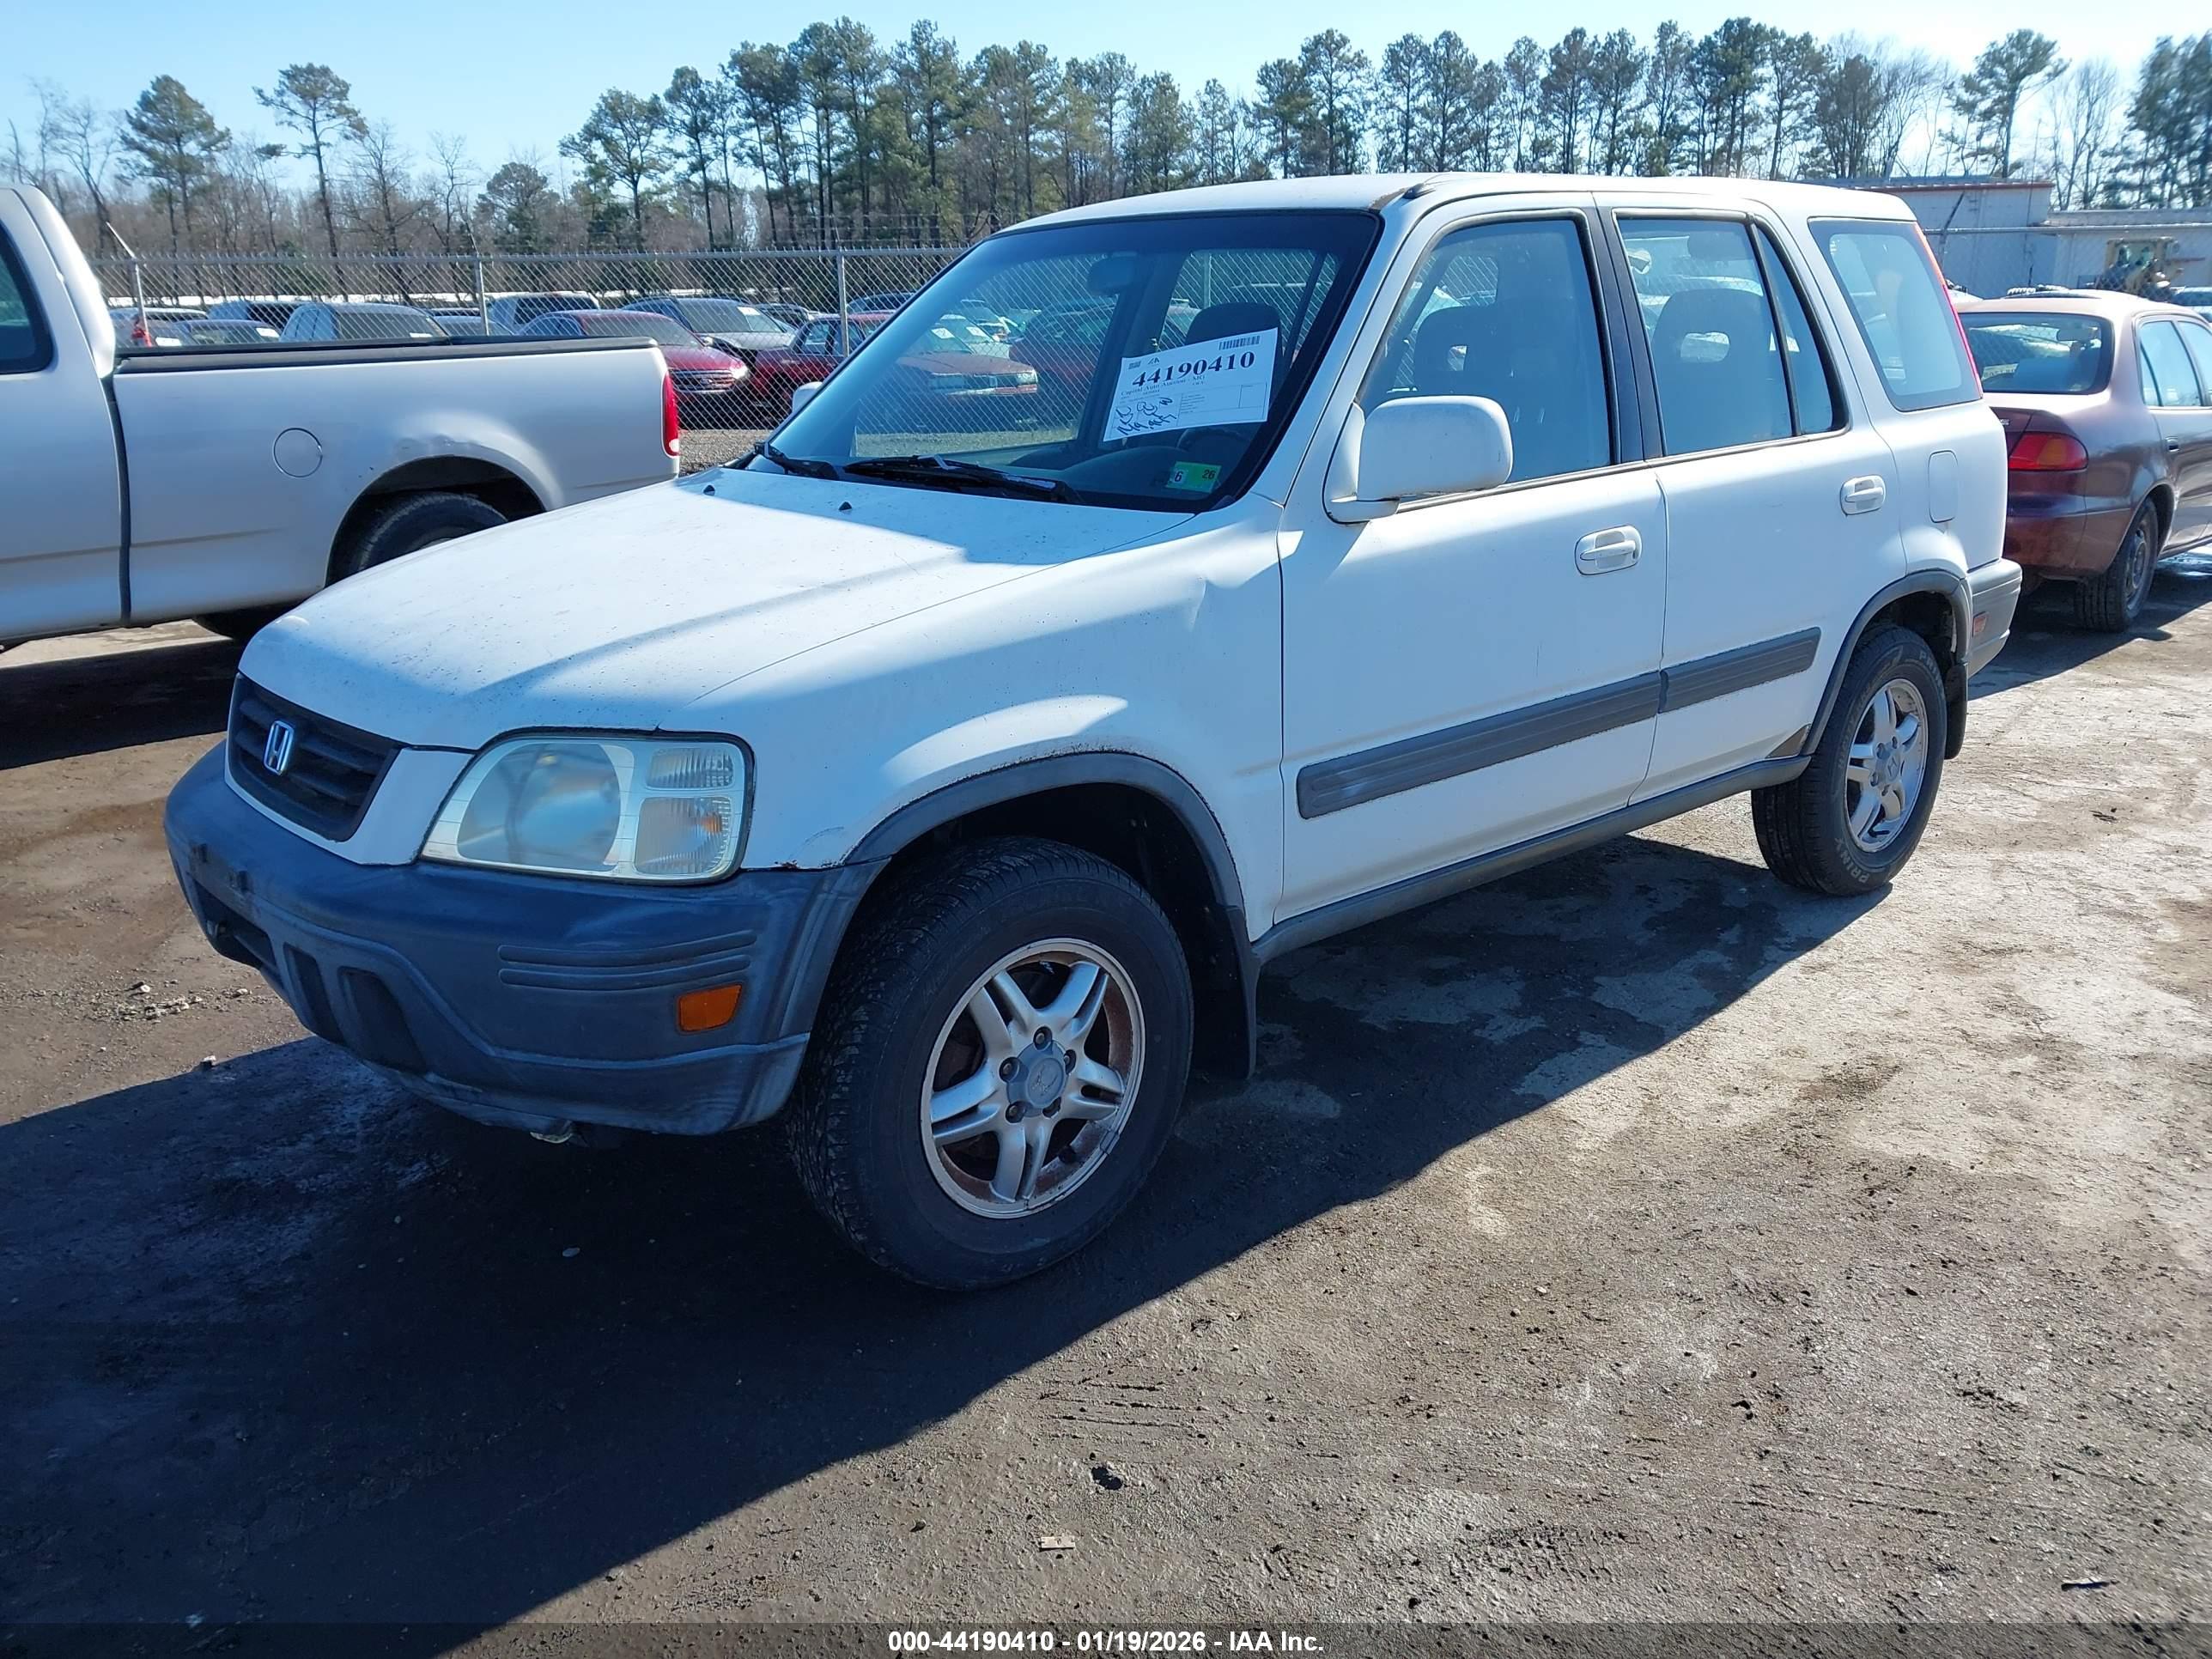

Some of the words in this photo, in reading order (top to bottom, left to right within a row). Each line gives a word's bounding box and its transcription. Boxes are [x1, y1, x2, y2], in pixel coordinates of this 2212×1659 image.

[1132, 351, 1255, 387] 44190410
[1175, 471, 1183, 482] 6
[1202, 469, 1216, 480] 26
